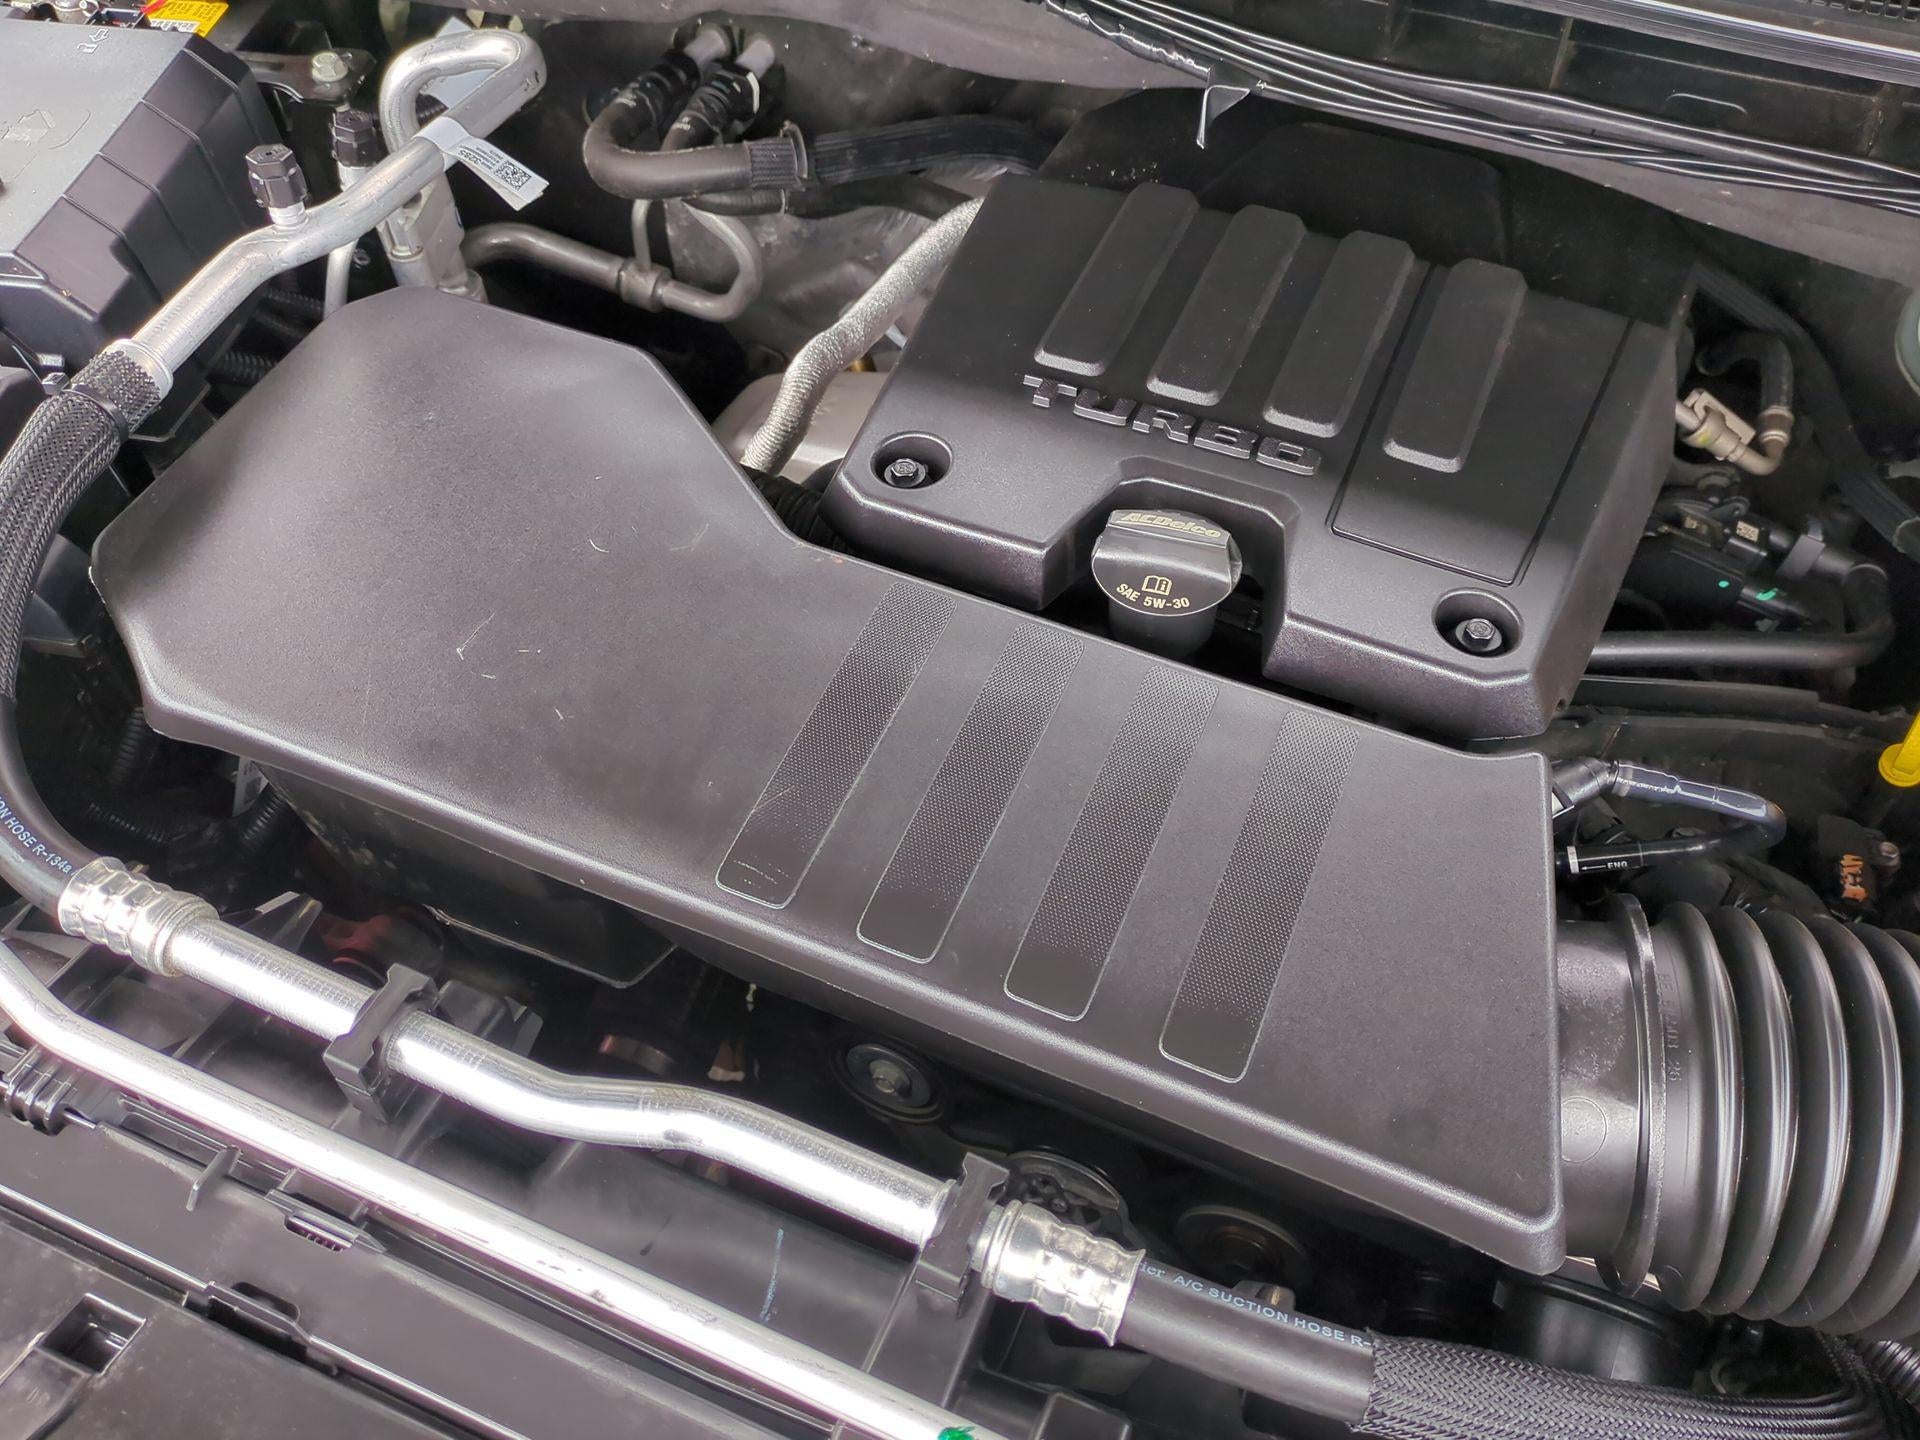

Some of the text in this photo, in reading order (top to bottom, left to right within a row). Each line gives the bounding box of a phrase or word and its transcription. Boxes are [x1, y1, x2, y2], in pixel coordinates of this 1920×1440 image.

[1023, 374, 1322, 476] TURBO
[1116, 512, 1222, 538] ACDelco
[1116, 583, 1190, 609] SAE 5W-30
[4, 816, 37, 848] HOSE
[31, 843, 72, 874] R-134a
[1140, 1261, 1166, 1279] ier
[1174, 1275, 1204, 1292] A/C
[1208, 1287, 1289, 1323] SUCTION
[1295, 1317, 1345, 1341] HOSE
